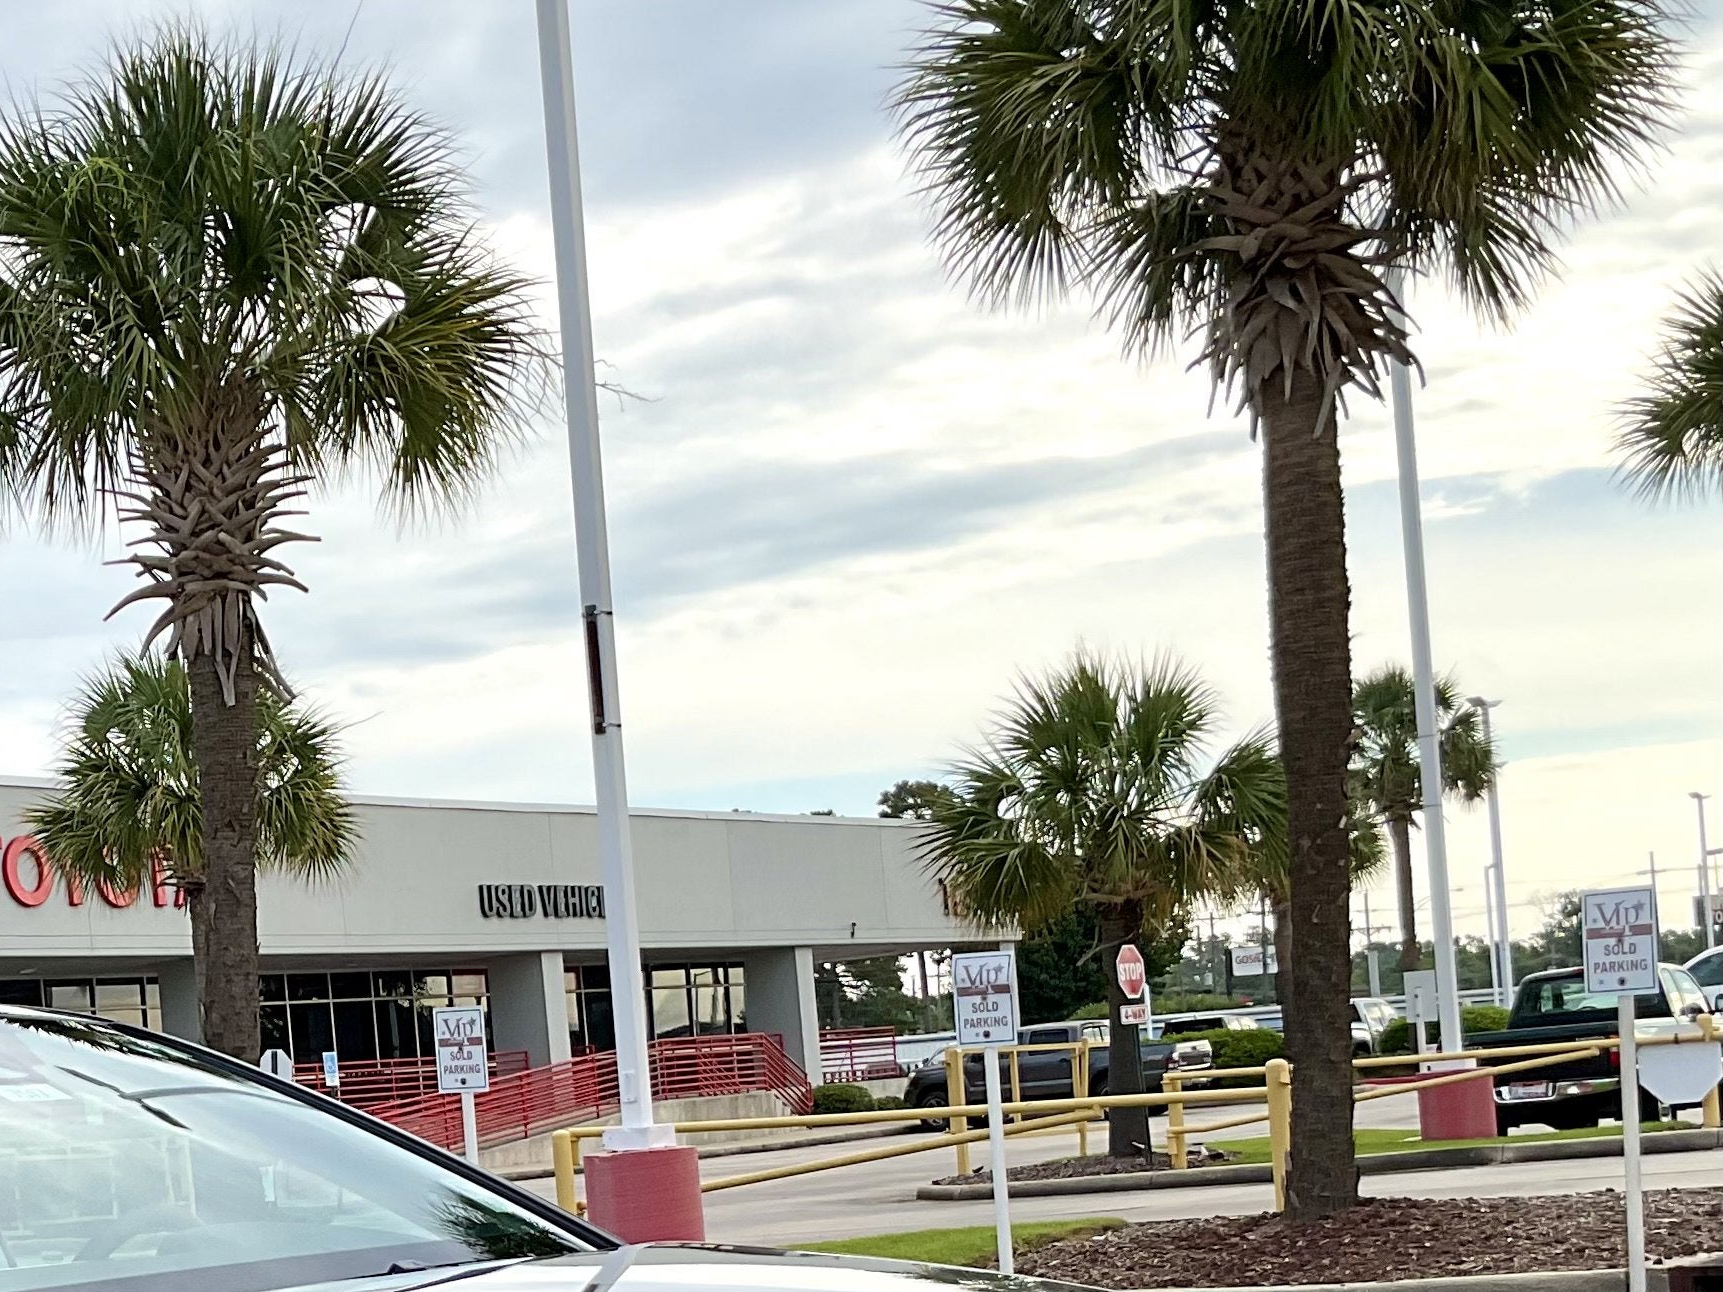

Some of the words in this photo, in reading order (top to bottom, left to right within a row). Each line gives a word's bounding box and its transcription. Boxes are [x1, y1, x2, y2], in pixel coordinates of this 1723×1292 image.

[478, 883, 537, 919] USED
[1604, 943, 1637, 956] SOLD
[1119, 962, 1142, 980] STOP
[1593, 958, 1648, 974] PARKING
[971, 1001, 999, 1013] SOLD
[963, 1016, 1008, 1029] PARKING
[450, 1050, 473, 1061] SOLD
[444, 1064, 481, 1074] PARKING
